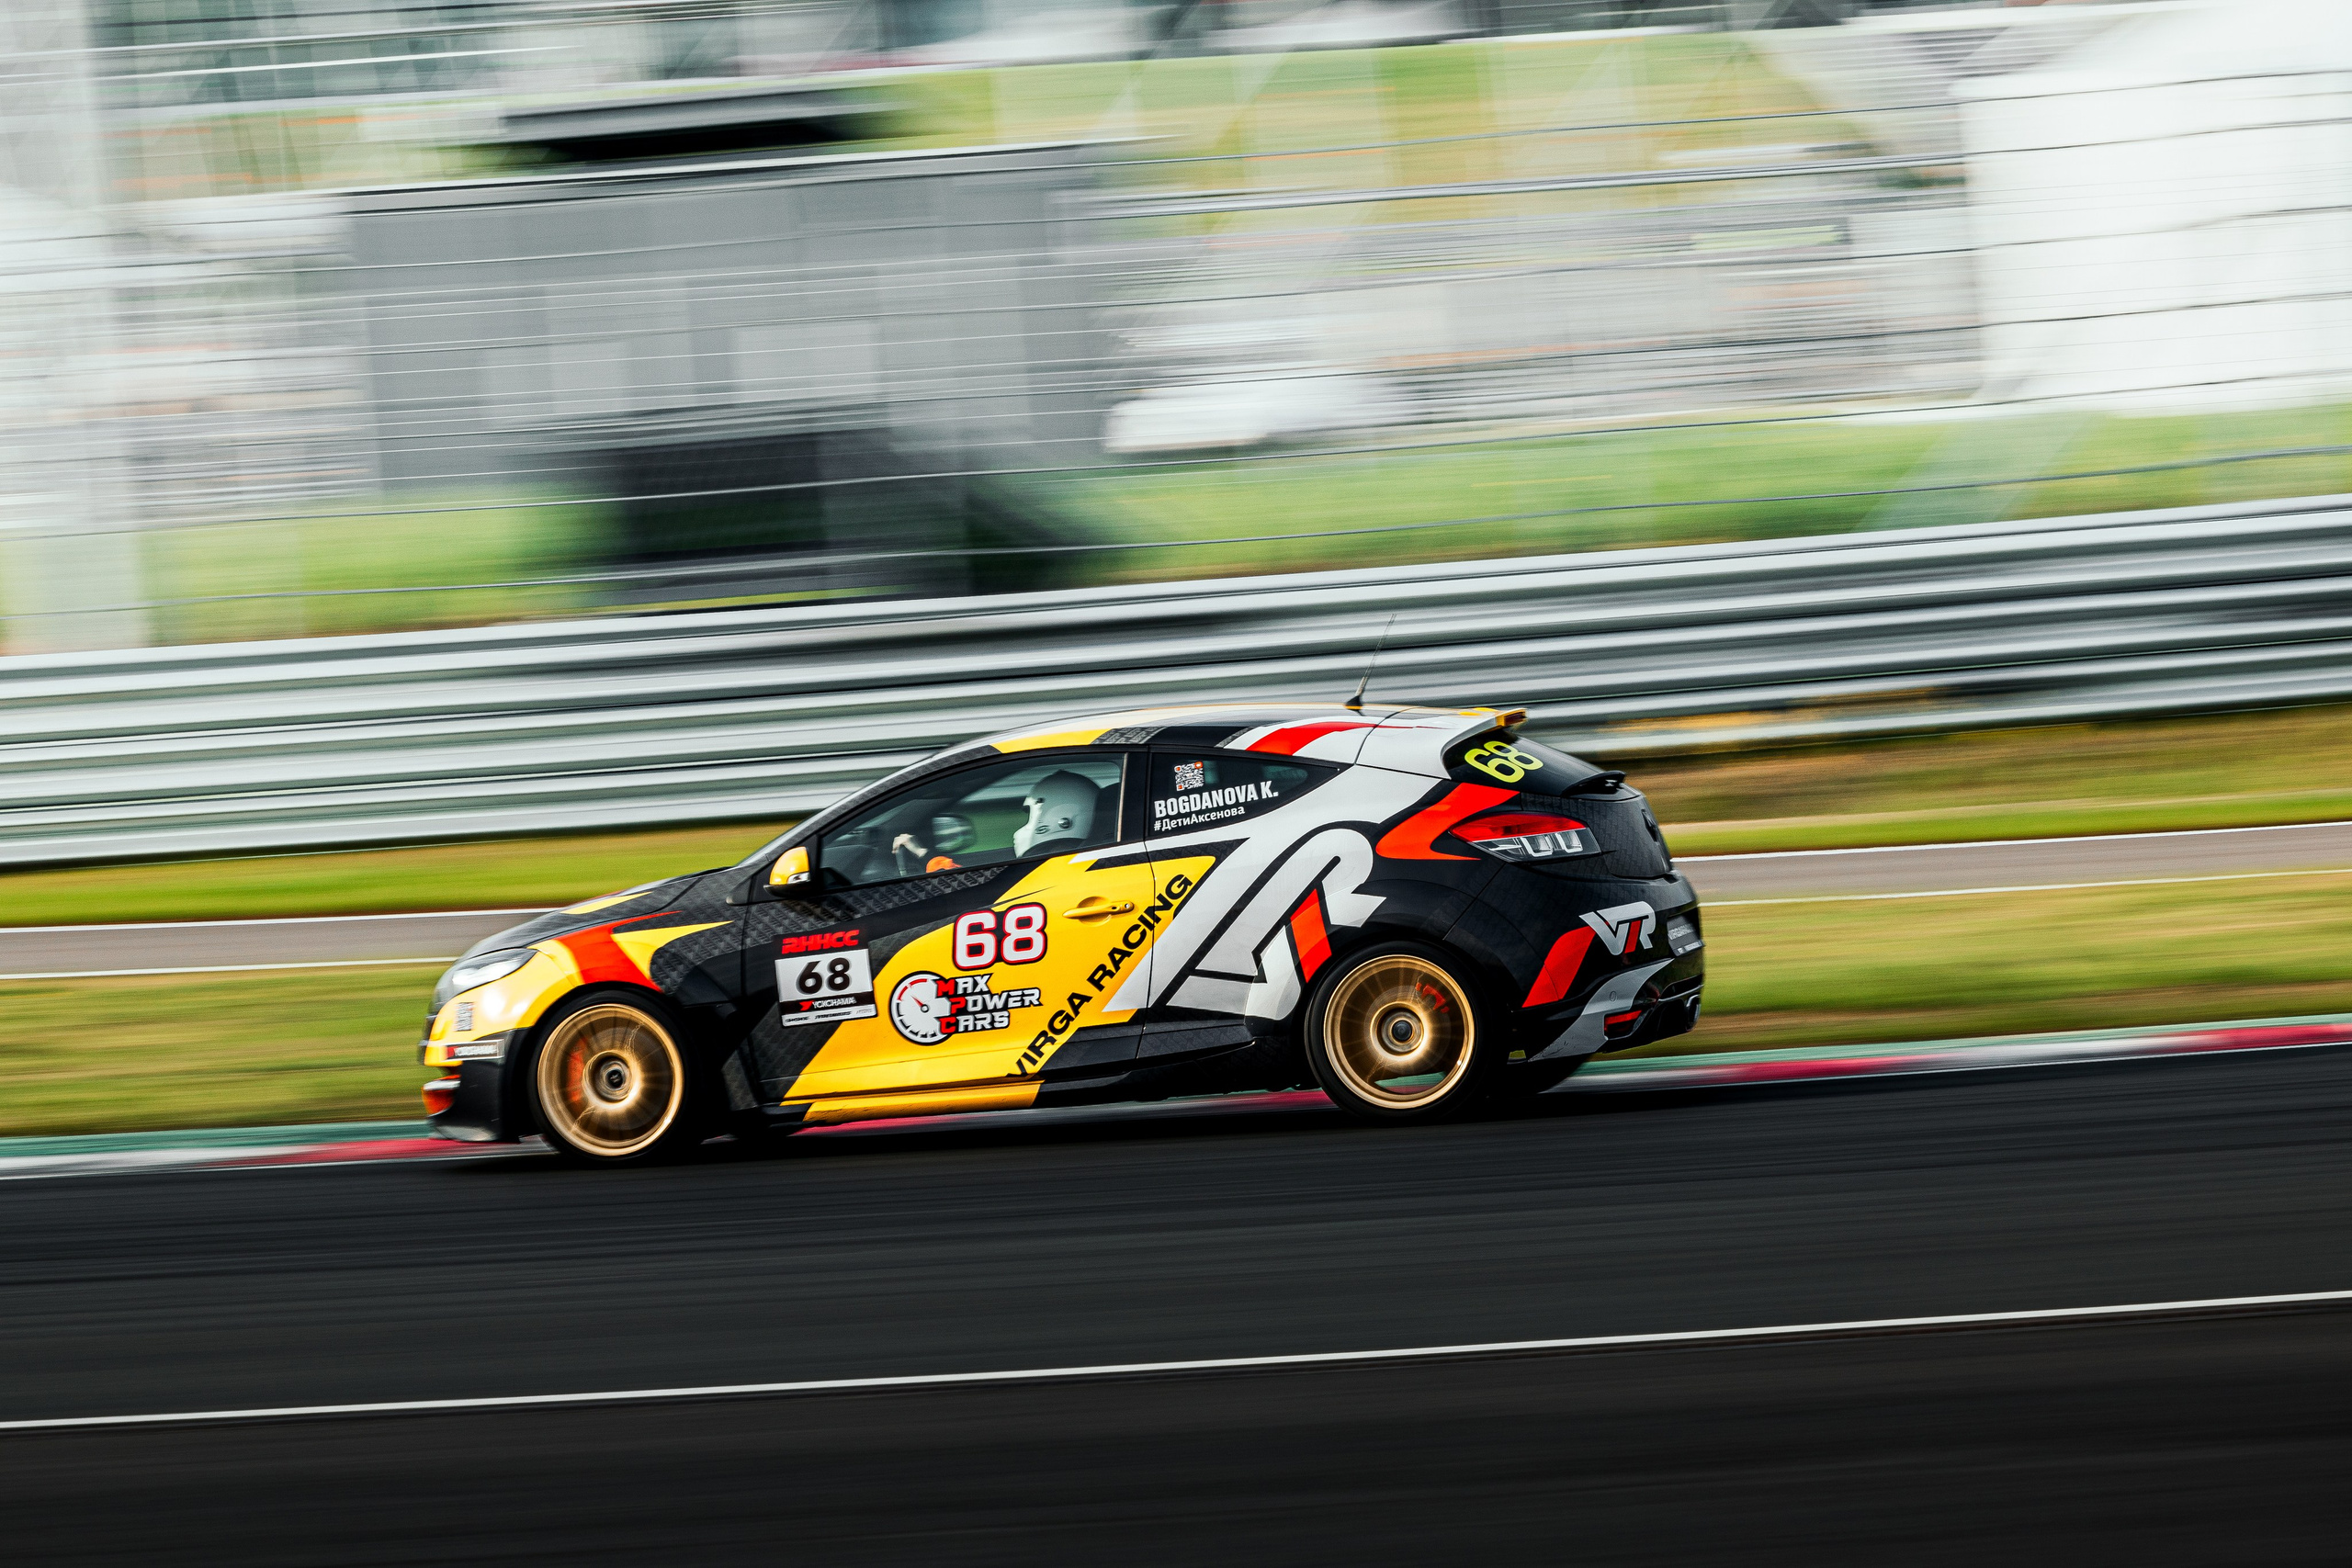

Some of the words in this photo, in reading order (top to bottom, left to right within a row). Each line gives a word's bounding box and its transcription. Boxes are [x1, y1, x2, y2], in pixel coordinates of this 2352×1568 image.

[1464, 740, 1544, 783] 68
[1154, 784, 1259, 818] BOGDANOVA
[1260, 781, 1279, 799] K.
[1154, 806, 1246, 831] #ДетиАксенова
[782, 930, 860, 954] RHHCC
[953, 902, 1047, 971] 68
[1086, 874, 1193, 992] RACING
[796, 957, 851, 995] 68
[936, 975, 991, 998] MAX
[949, 988, 1041, 1014] POWER
[939, 1011, 1010, 1034] CARS
